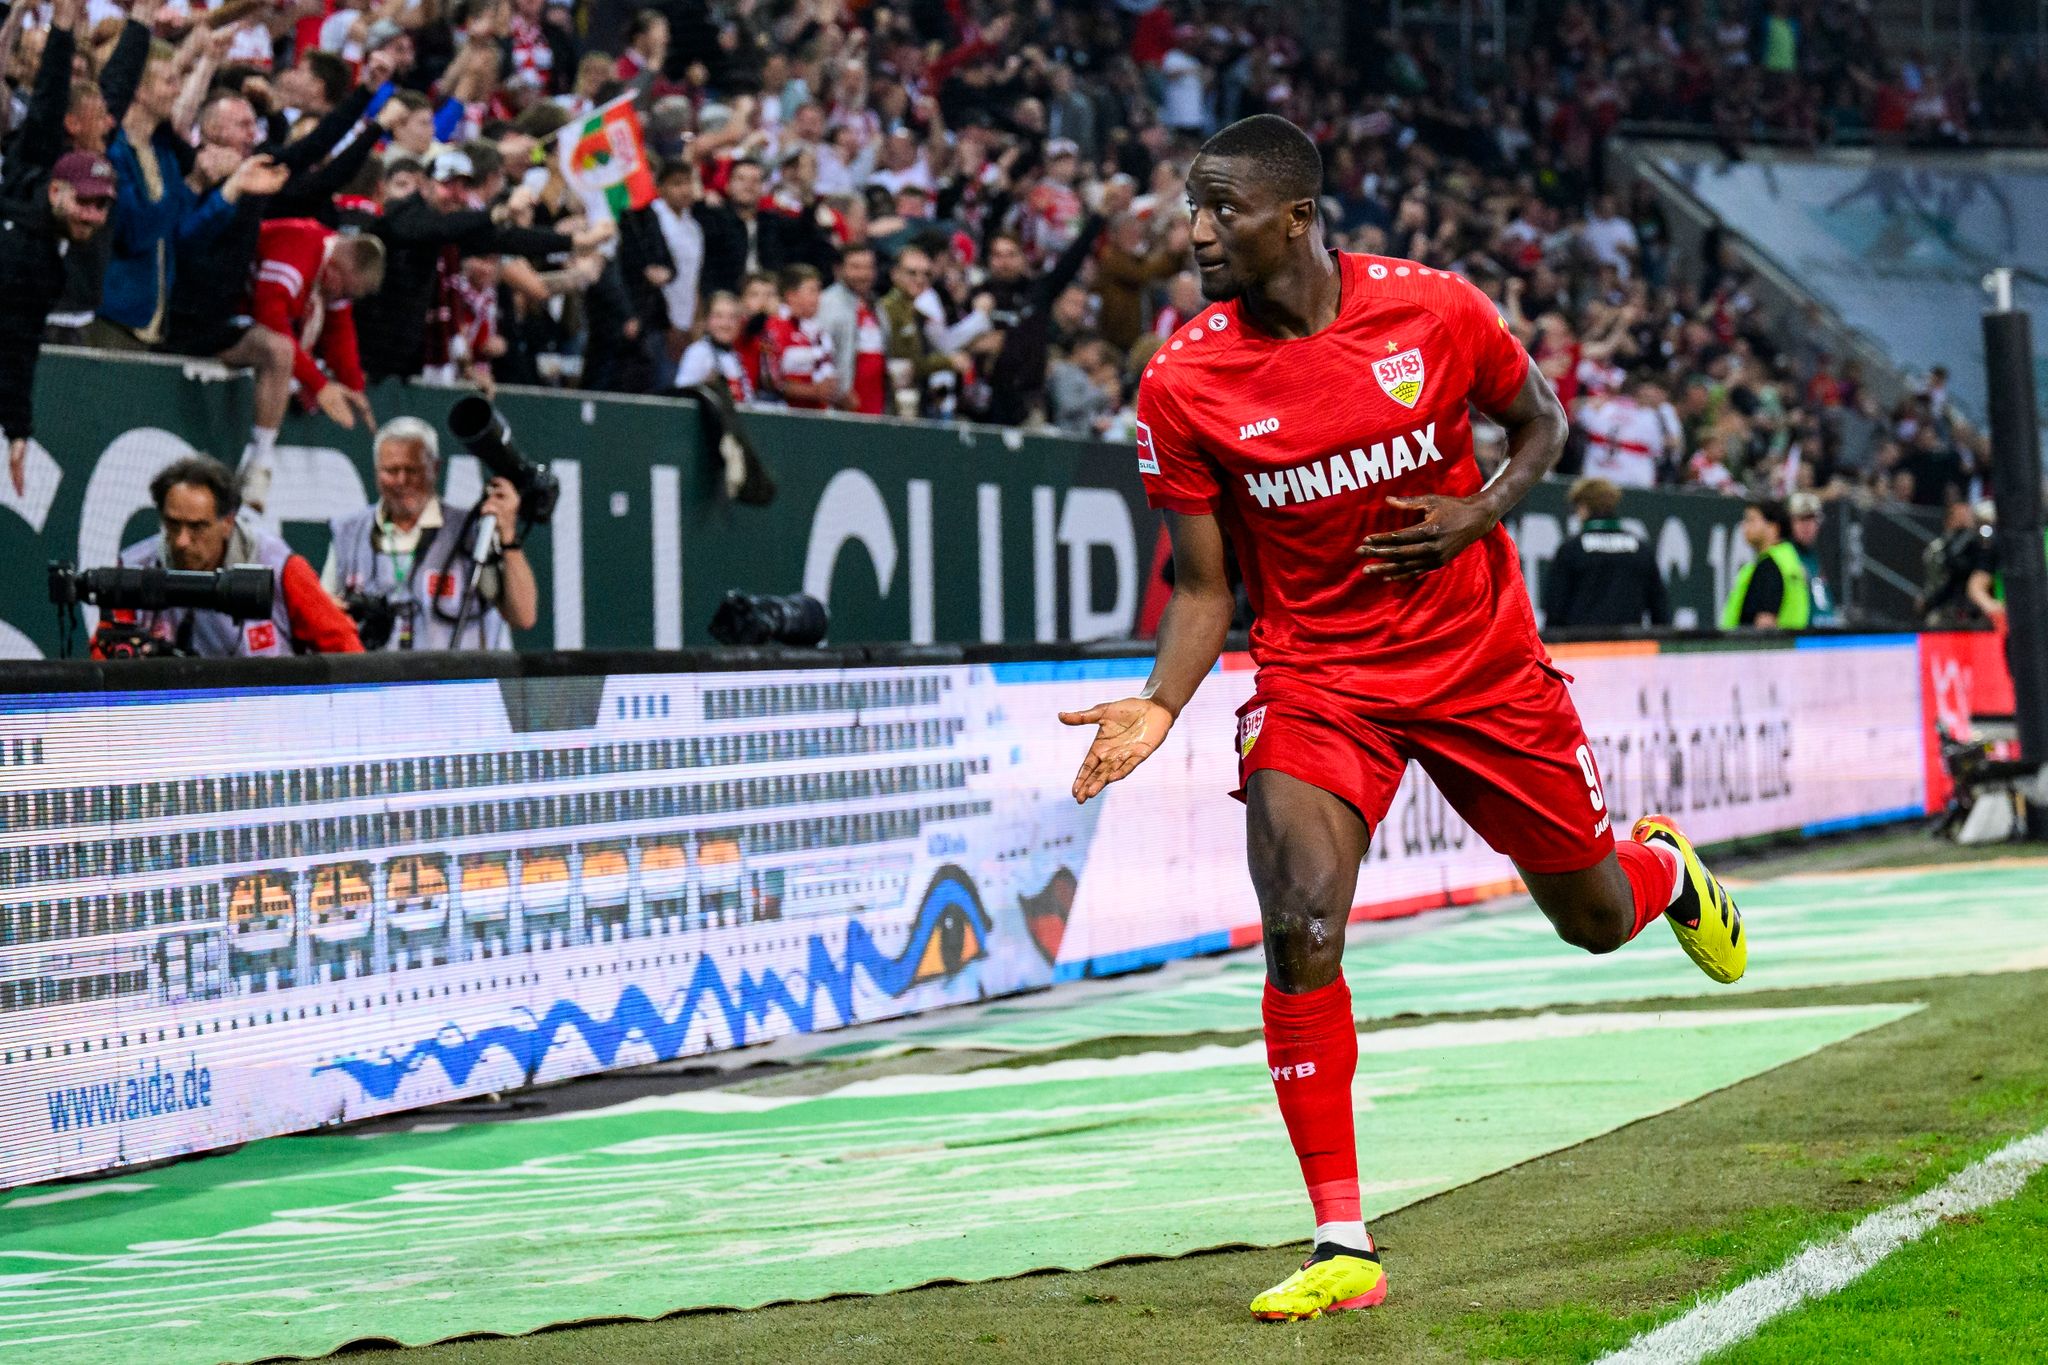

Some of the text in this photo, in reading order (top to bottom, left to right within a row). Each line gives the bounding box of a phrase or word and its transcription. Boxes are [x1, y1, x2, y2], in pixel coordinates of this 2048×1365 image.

[1239, 417, 1280, 441] JAKO
[1244, 422, 1443, 508] WINAMAX
[1576, 744, 1604, 811] 9
[47, 1051, 212, 1133] www.aida.de
[1269, 1061, 1317, 1081] VfB
